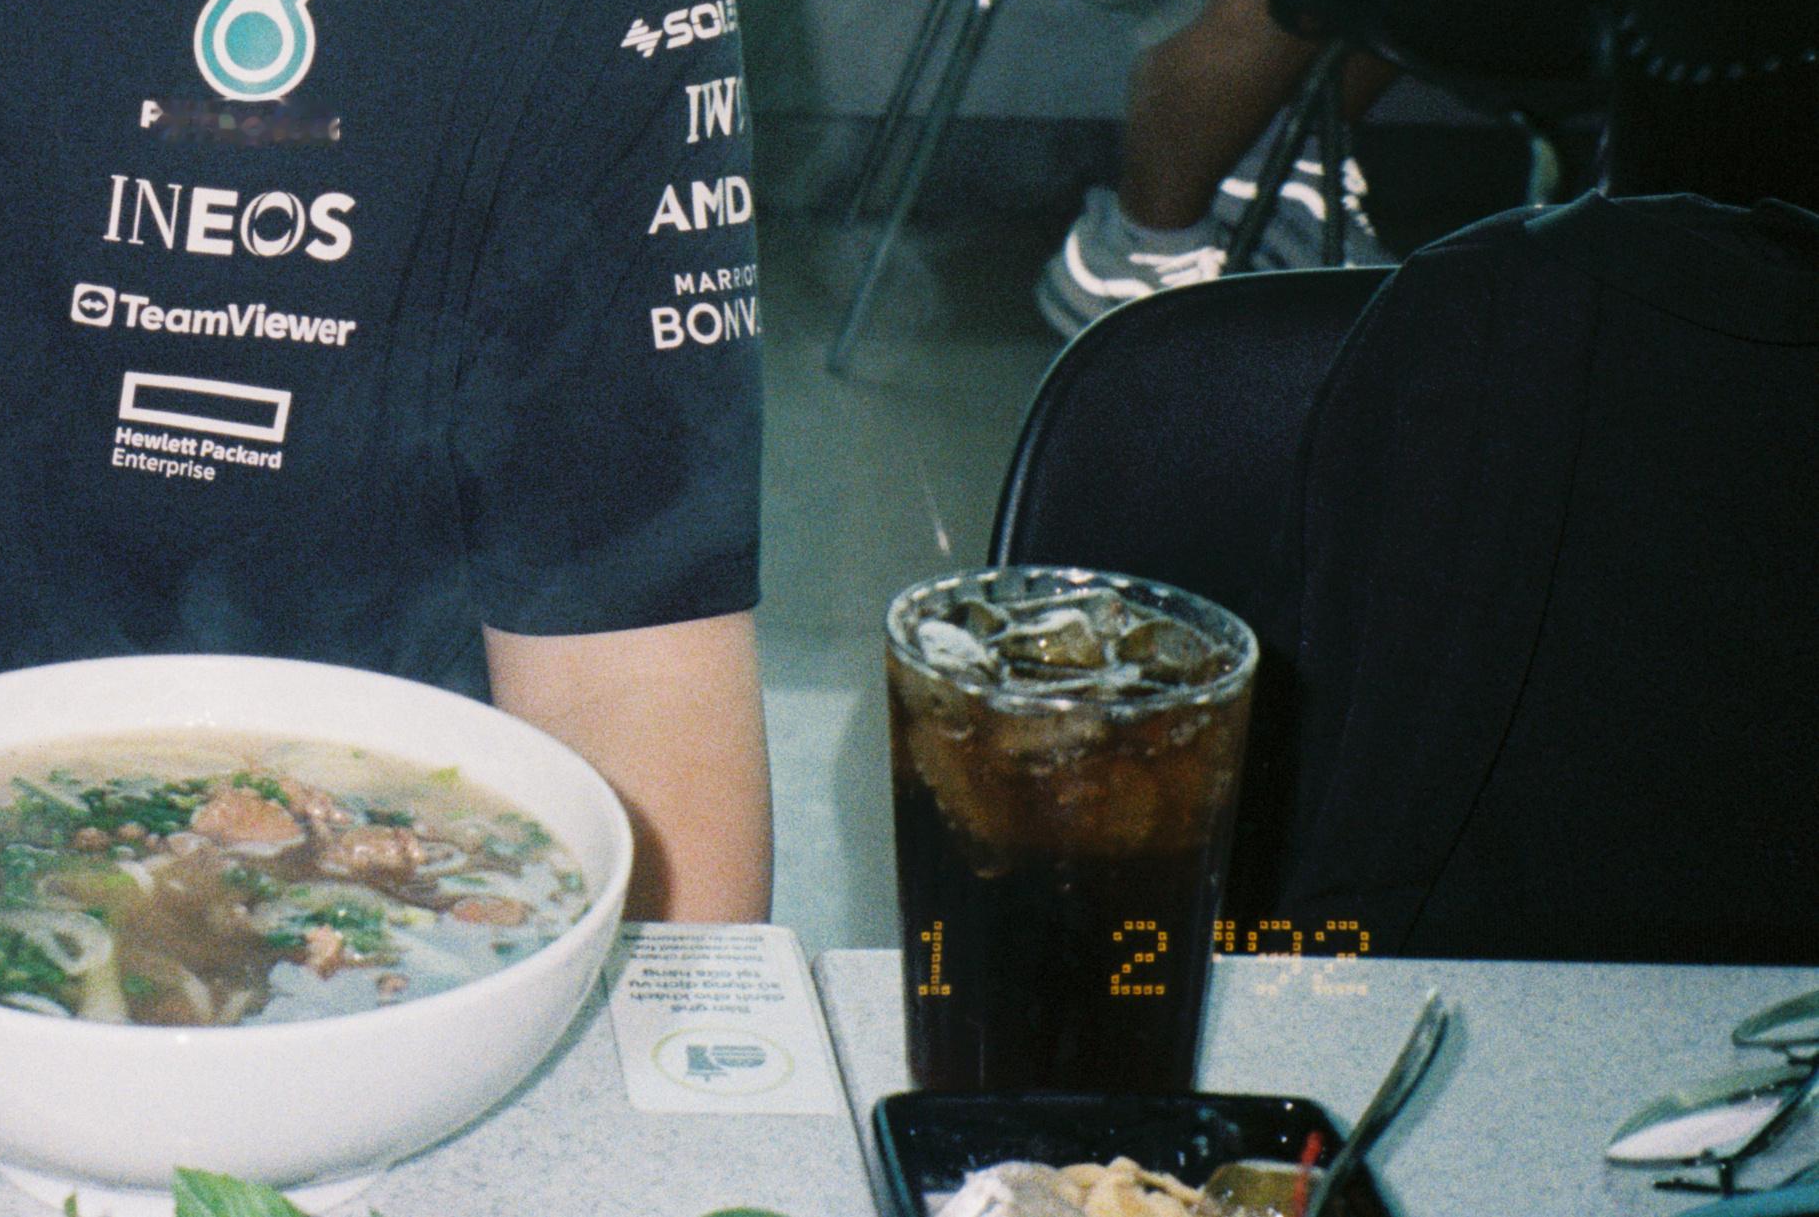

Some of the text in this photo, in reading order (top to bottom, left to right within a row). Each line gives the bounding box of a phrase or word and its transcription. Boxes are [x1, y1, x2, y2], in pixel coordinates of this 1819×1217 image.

[102, 174, 356, 262] INEOS
[647, 175, 753, 235] AMD
[118, 292, 357, 347] TeamViewer
[650, 296, 762, 350] BONV
[111, 447, 216, 481] Enterprise
[114, 426, 283, 470] Hewlett Packard
